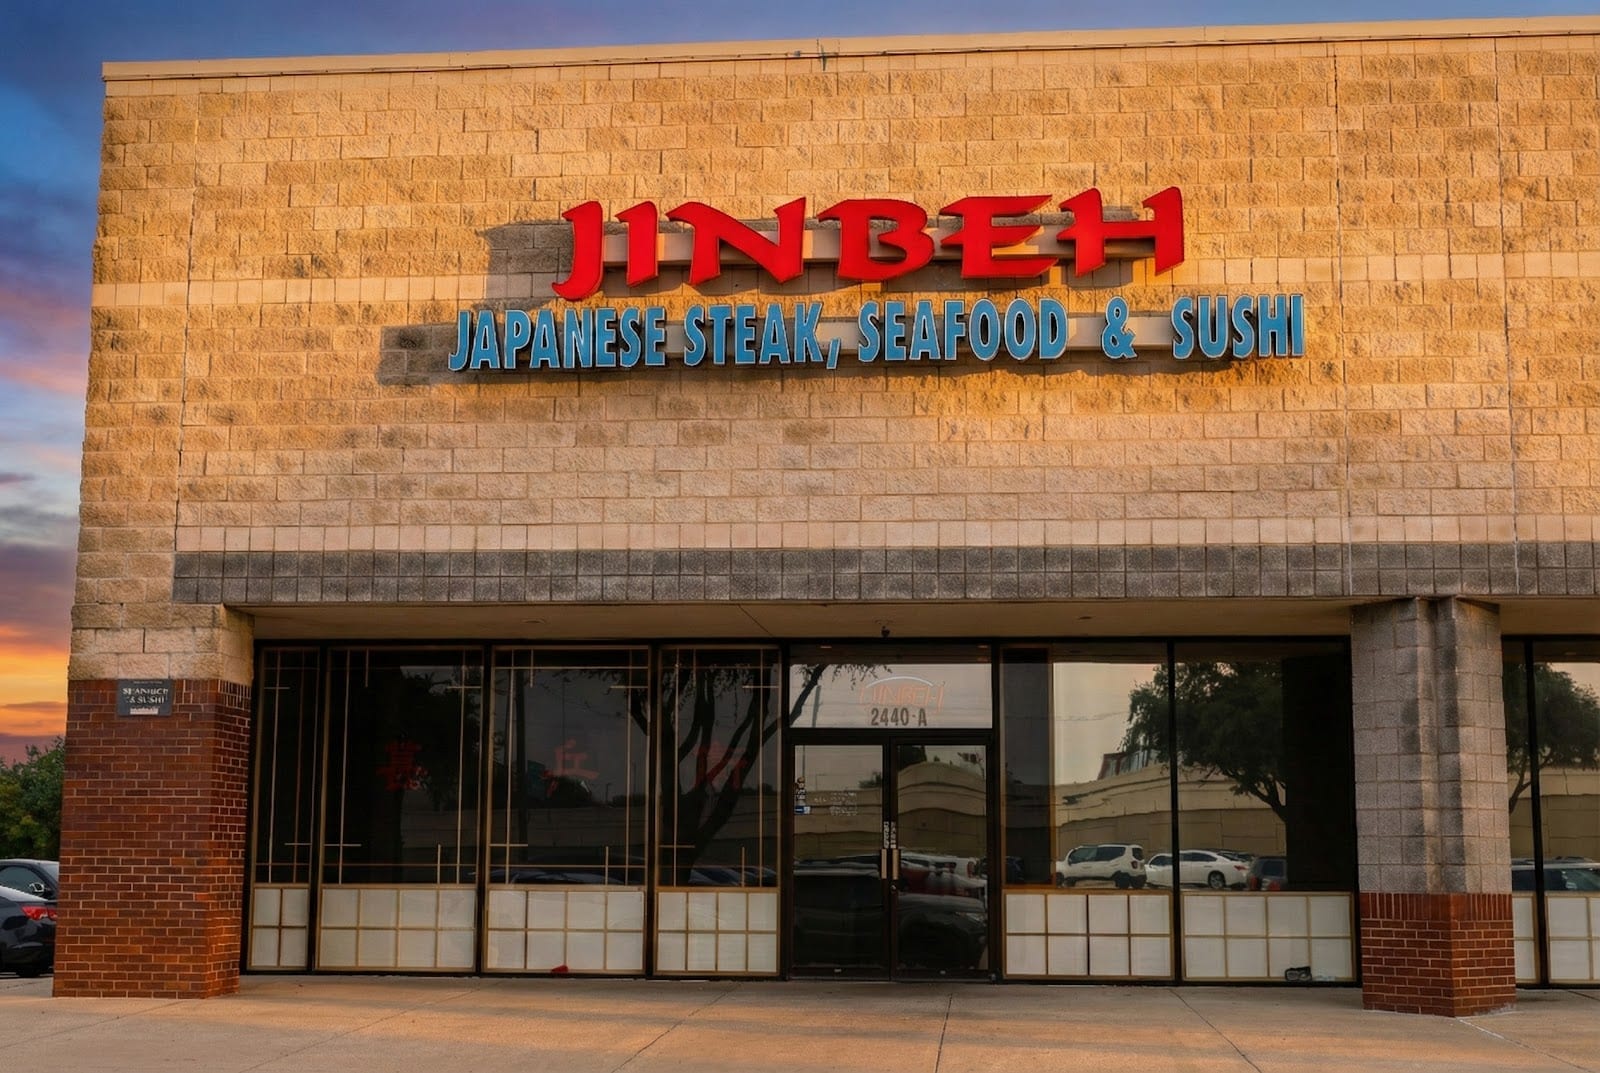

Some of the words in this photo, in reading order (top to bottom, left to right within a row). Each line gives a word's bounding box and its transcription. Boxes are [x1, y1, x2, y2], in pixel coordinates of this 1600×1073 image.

[552, 186, 1185, 302] JINBEH
[447, 306, 666, 372] JAPANESE
[684, 302, 842, 370] STEAK,
[857, 297, 1069, 363] SEAFOOD
[1101, 296, 1138, 360] &
[1171, 294, 1305, 359] SUSHI
[870, 707, 928, 727] 2440-A
